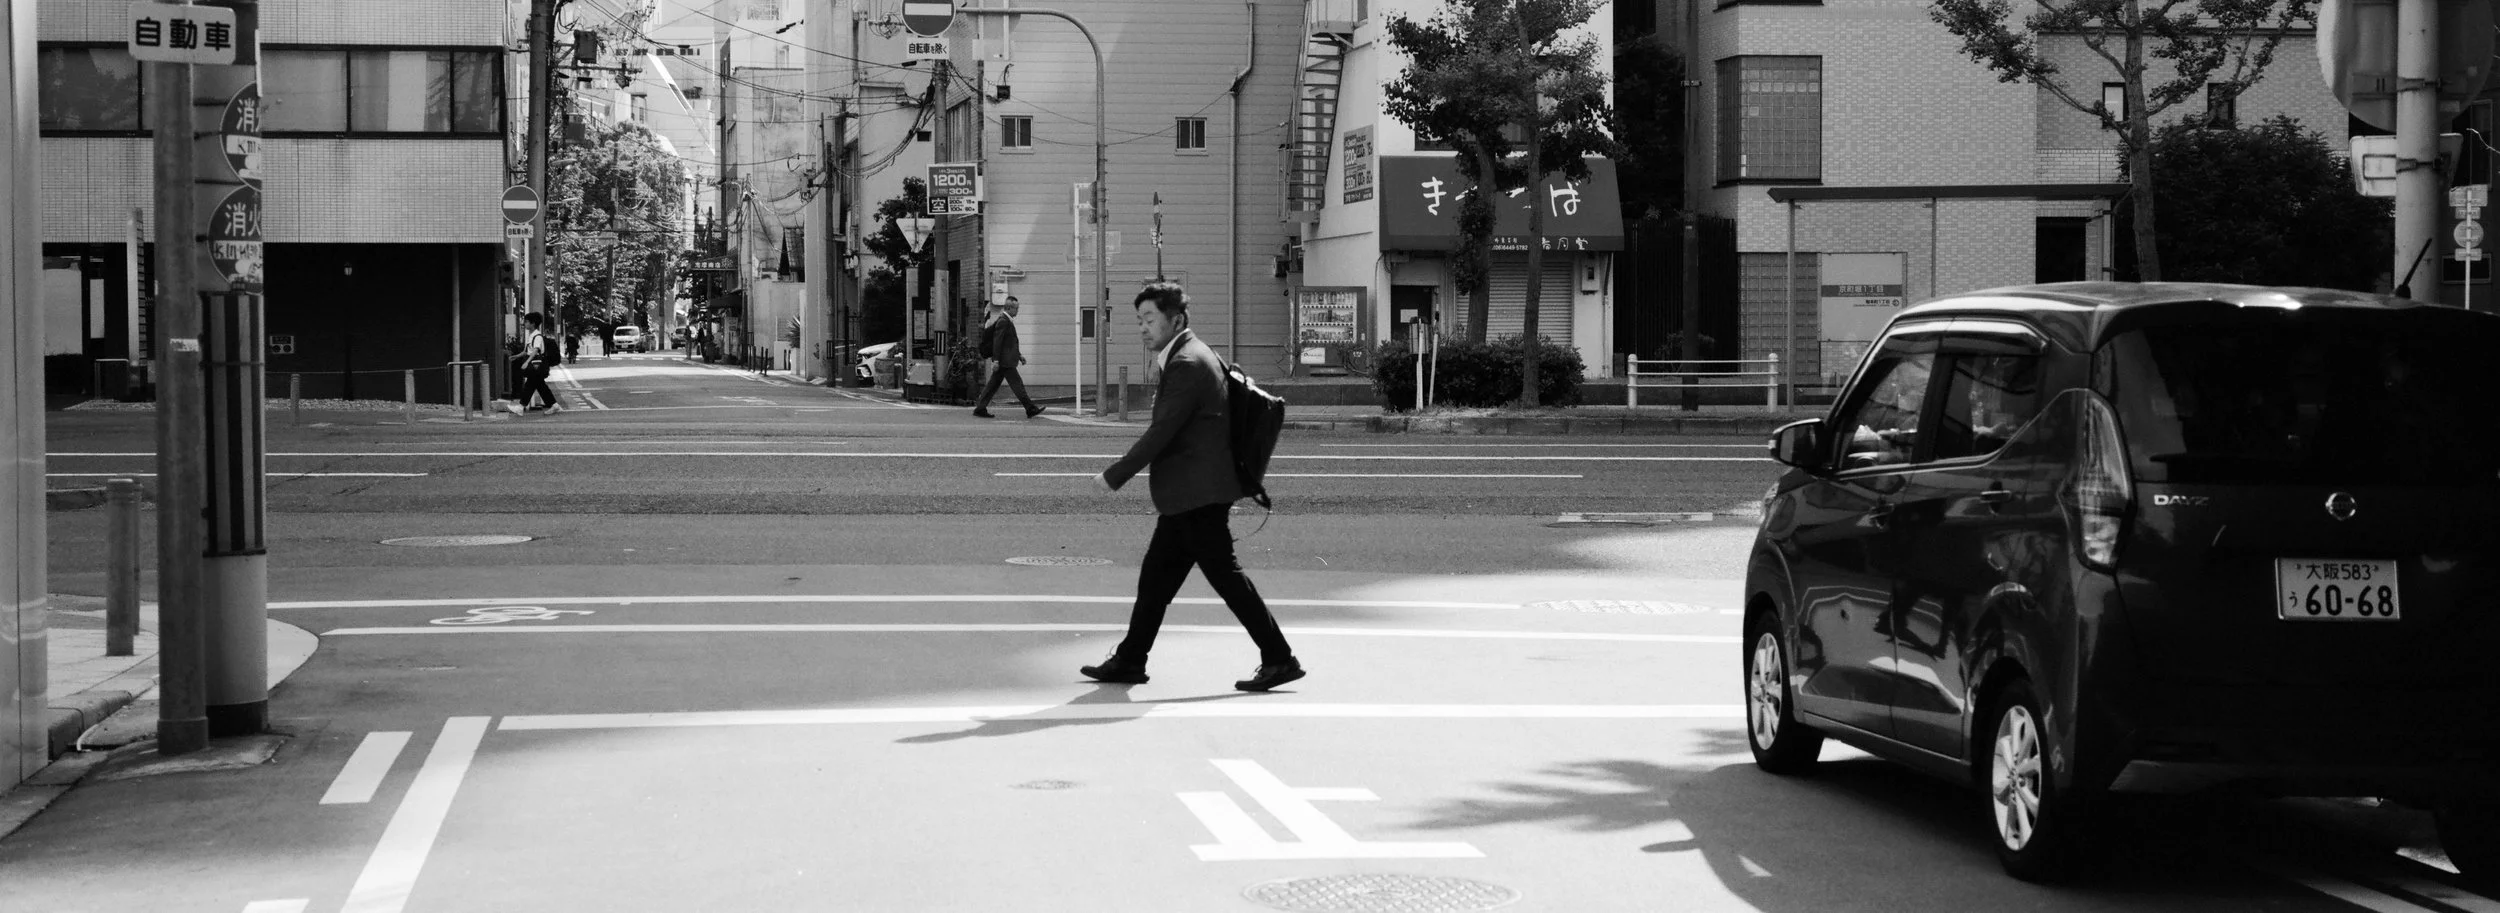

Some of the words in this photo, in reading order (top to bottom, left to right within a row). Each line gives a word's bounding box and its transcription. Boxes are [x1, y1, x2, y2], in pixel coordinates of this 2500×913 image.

[136, 16, 231, 51] 自動車
[908, 43, 947, 54] 自転車を除く
[236, 98, 261, 133] 消
[931, 197, 947, 212] 空
[2289, 591, 2298, 608] う
[2305, 584, 2394, 617] 60-68
[1174, 759, 1487, 861] 止
